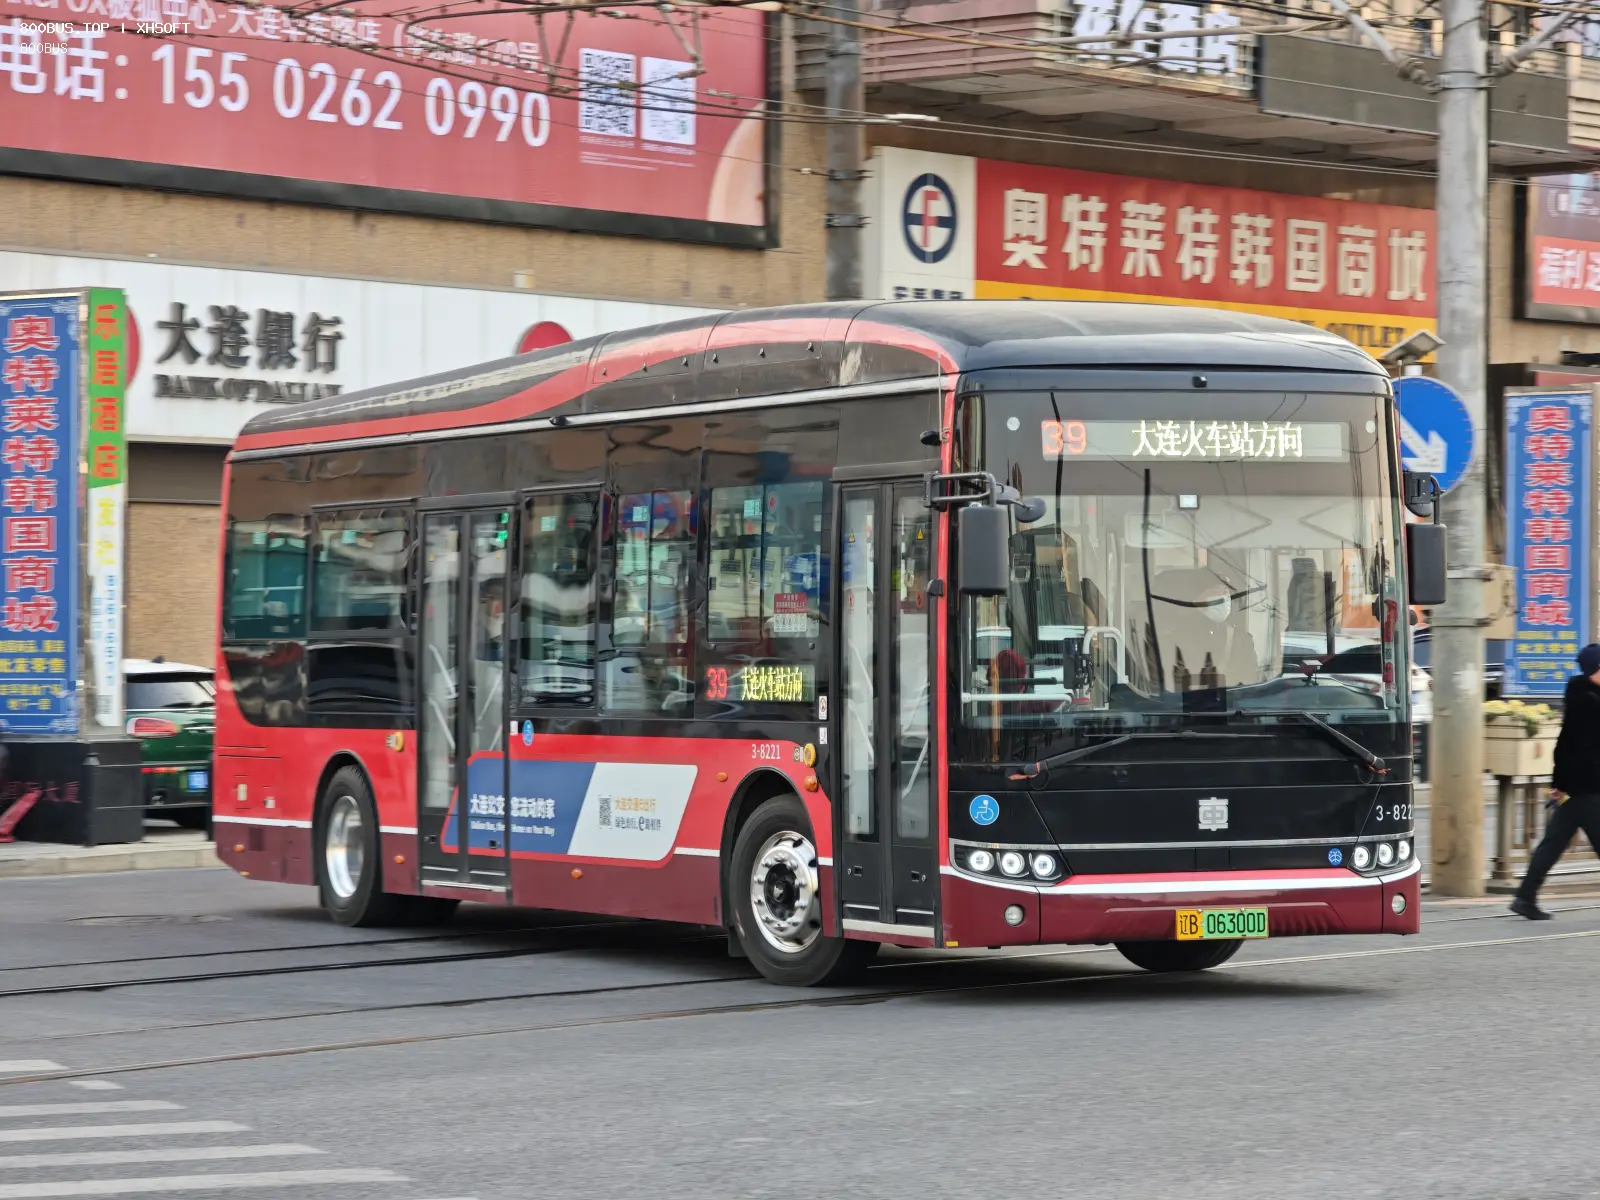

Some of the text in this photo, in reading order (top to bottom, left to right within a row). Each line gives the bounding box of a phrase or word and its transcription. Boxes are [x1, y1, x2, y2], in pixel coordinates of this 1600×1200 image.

[151, 43, 250, 112] 155
[272, 57, 403, 130] 0262
[423, 76, 551, 148] 0990
[1002, 188, 1429, 302] 奥特莱特韩国商城
[1041, 418, 1303, 458] 39 大连火车站方向
[2, 314, 60, 634] 奥特莱特韩国商城
[1522, 406, 1573, 626] 奥特莱特韩国商城
[706, 666, 729, 699] 39
[751, 743, 782, 761] 3-8221
[1375, 803, 1415, 822] 3-822
[1179, 912, 1266, 935] 辽B 06300D
